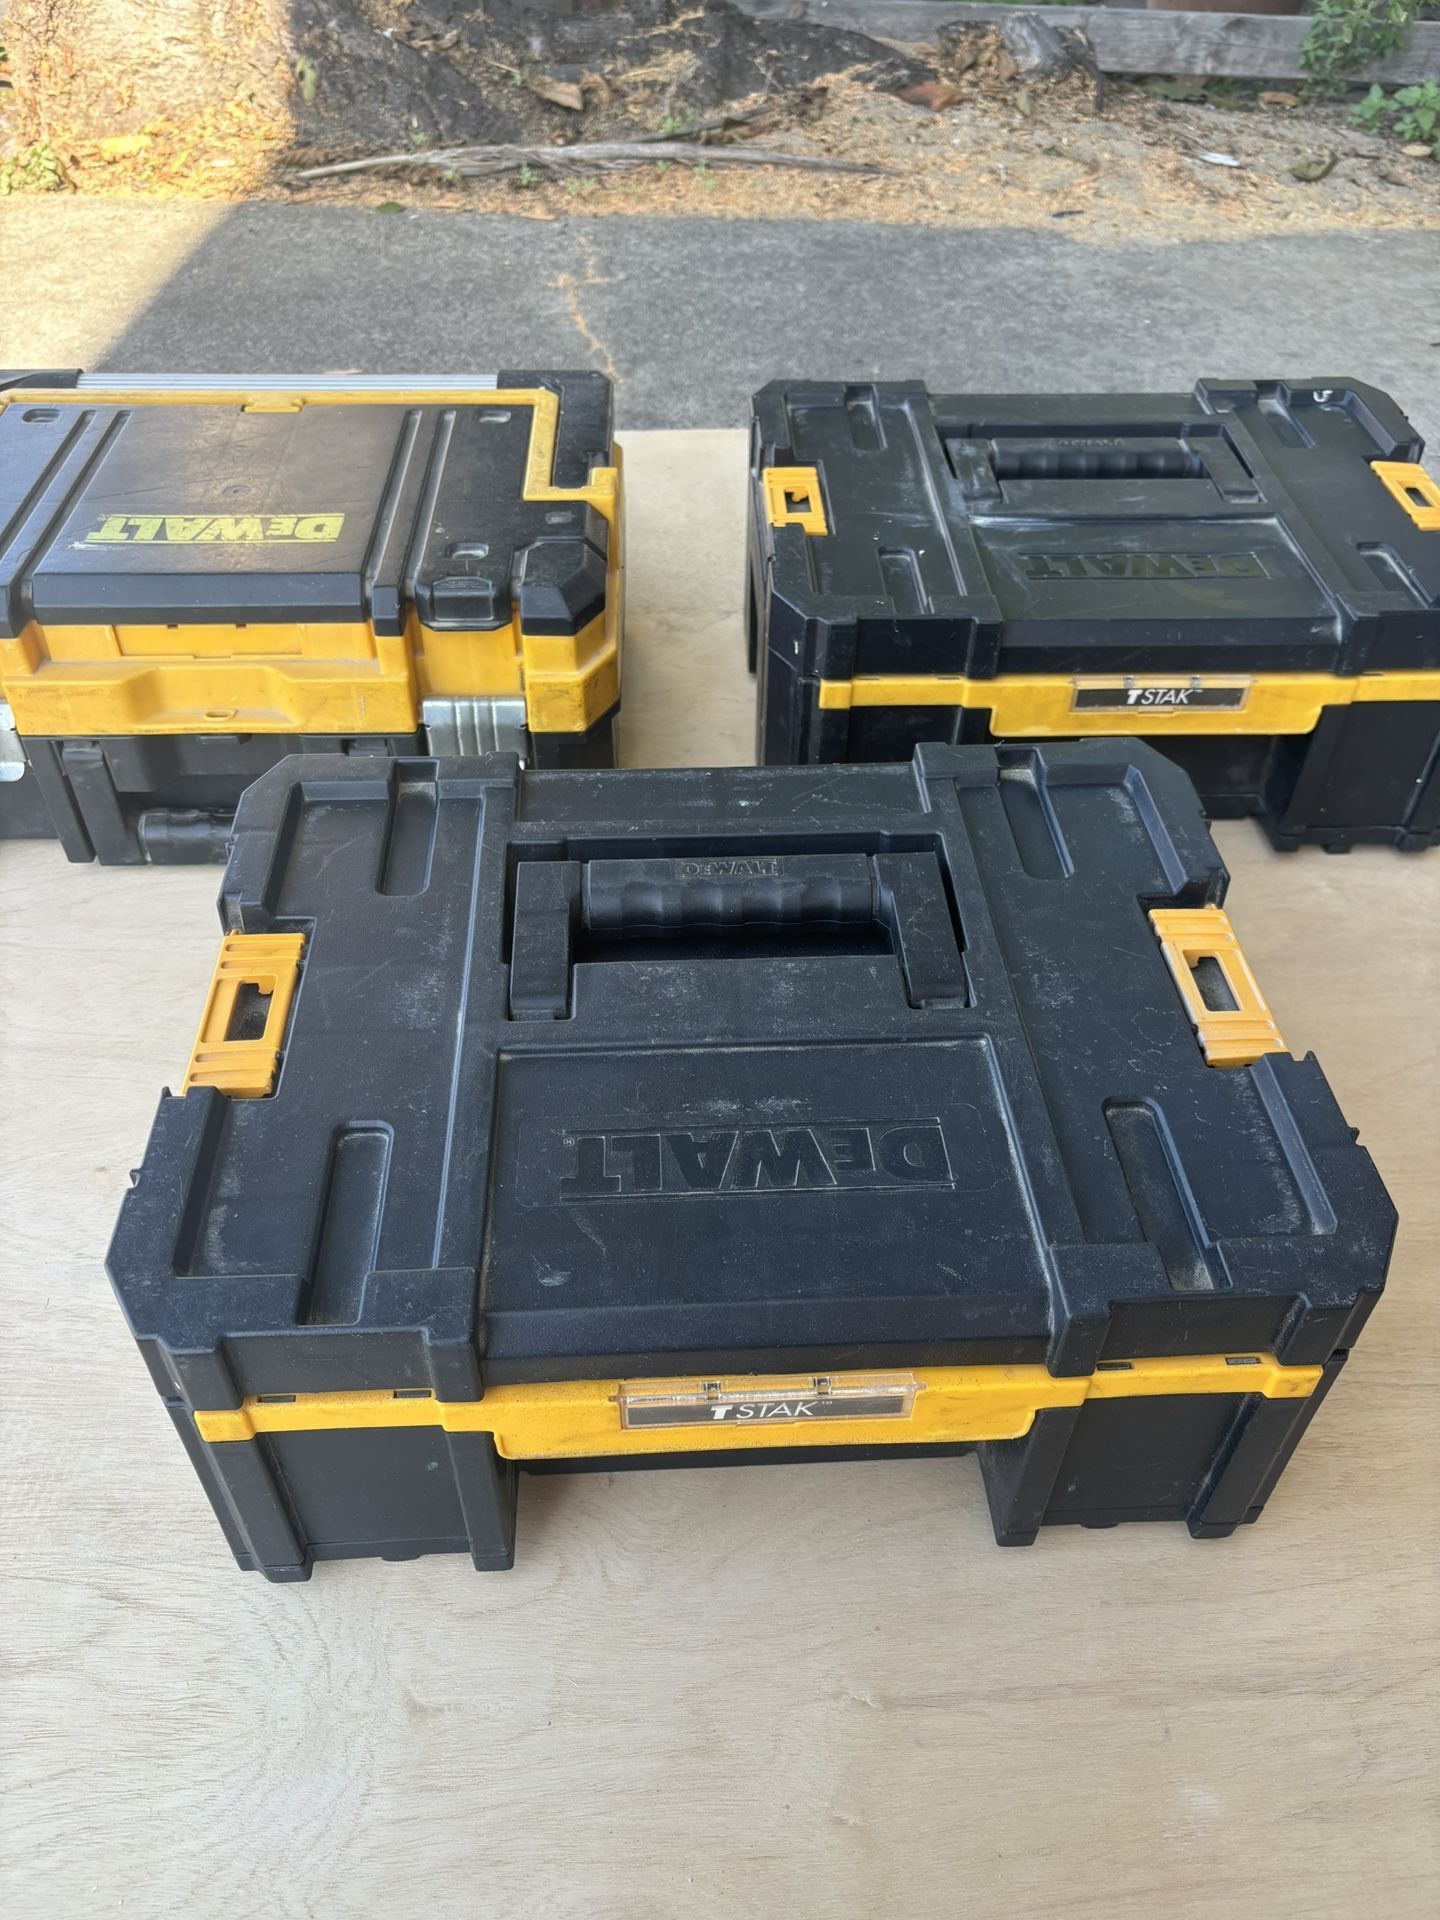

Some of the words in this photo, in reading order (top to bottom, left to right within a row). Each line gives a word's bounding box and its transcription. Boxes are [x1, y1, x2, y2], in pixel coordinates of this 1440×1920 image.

[86, 513, 345, 543] DEWALT
[1020, 553, 1270, 580] DEWALT
[680, 859, 779, 879] DEWALT
[560, 1119, 956, 1198] DEWALT
